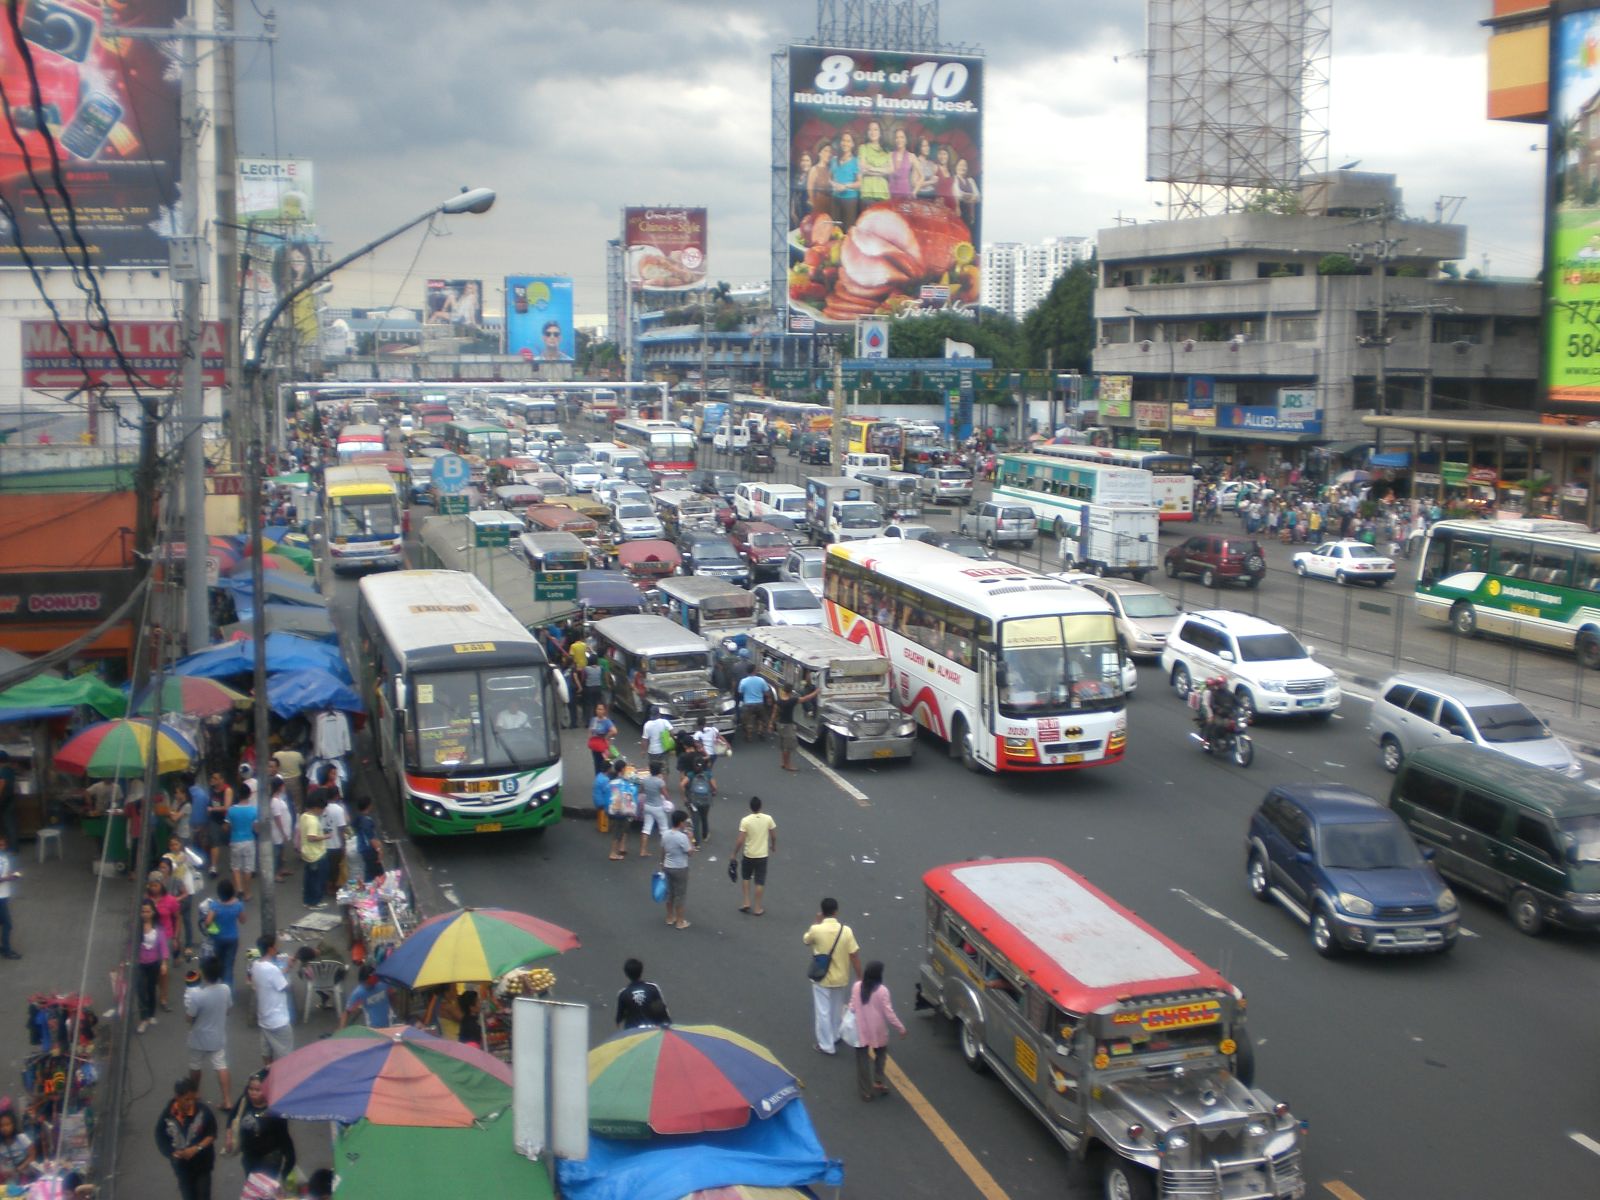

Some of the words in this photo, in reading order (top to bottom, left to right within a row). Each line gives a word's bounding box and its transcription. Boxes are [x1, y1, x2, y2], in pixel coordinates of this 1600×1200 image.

[815, 55, 855, 90] 8
[853, 69, 885, 82] out
[889, 69, 910, 84] of
[911, 62, 968, 97] 10
[794, 91, 873, 107] mothers
[877, 94, 929, 111] know
[932, 97, 979, 113] best.
[24, 324, 141, 353] MAHAL
[149, 323, 222, 353] KIA
[1244, 412, 1276, 428] ALLIED
[444, 457, 462, 478] B
[29, 594, 99, 611] DONUTS
